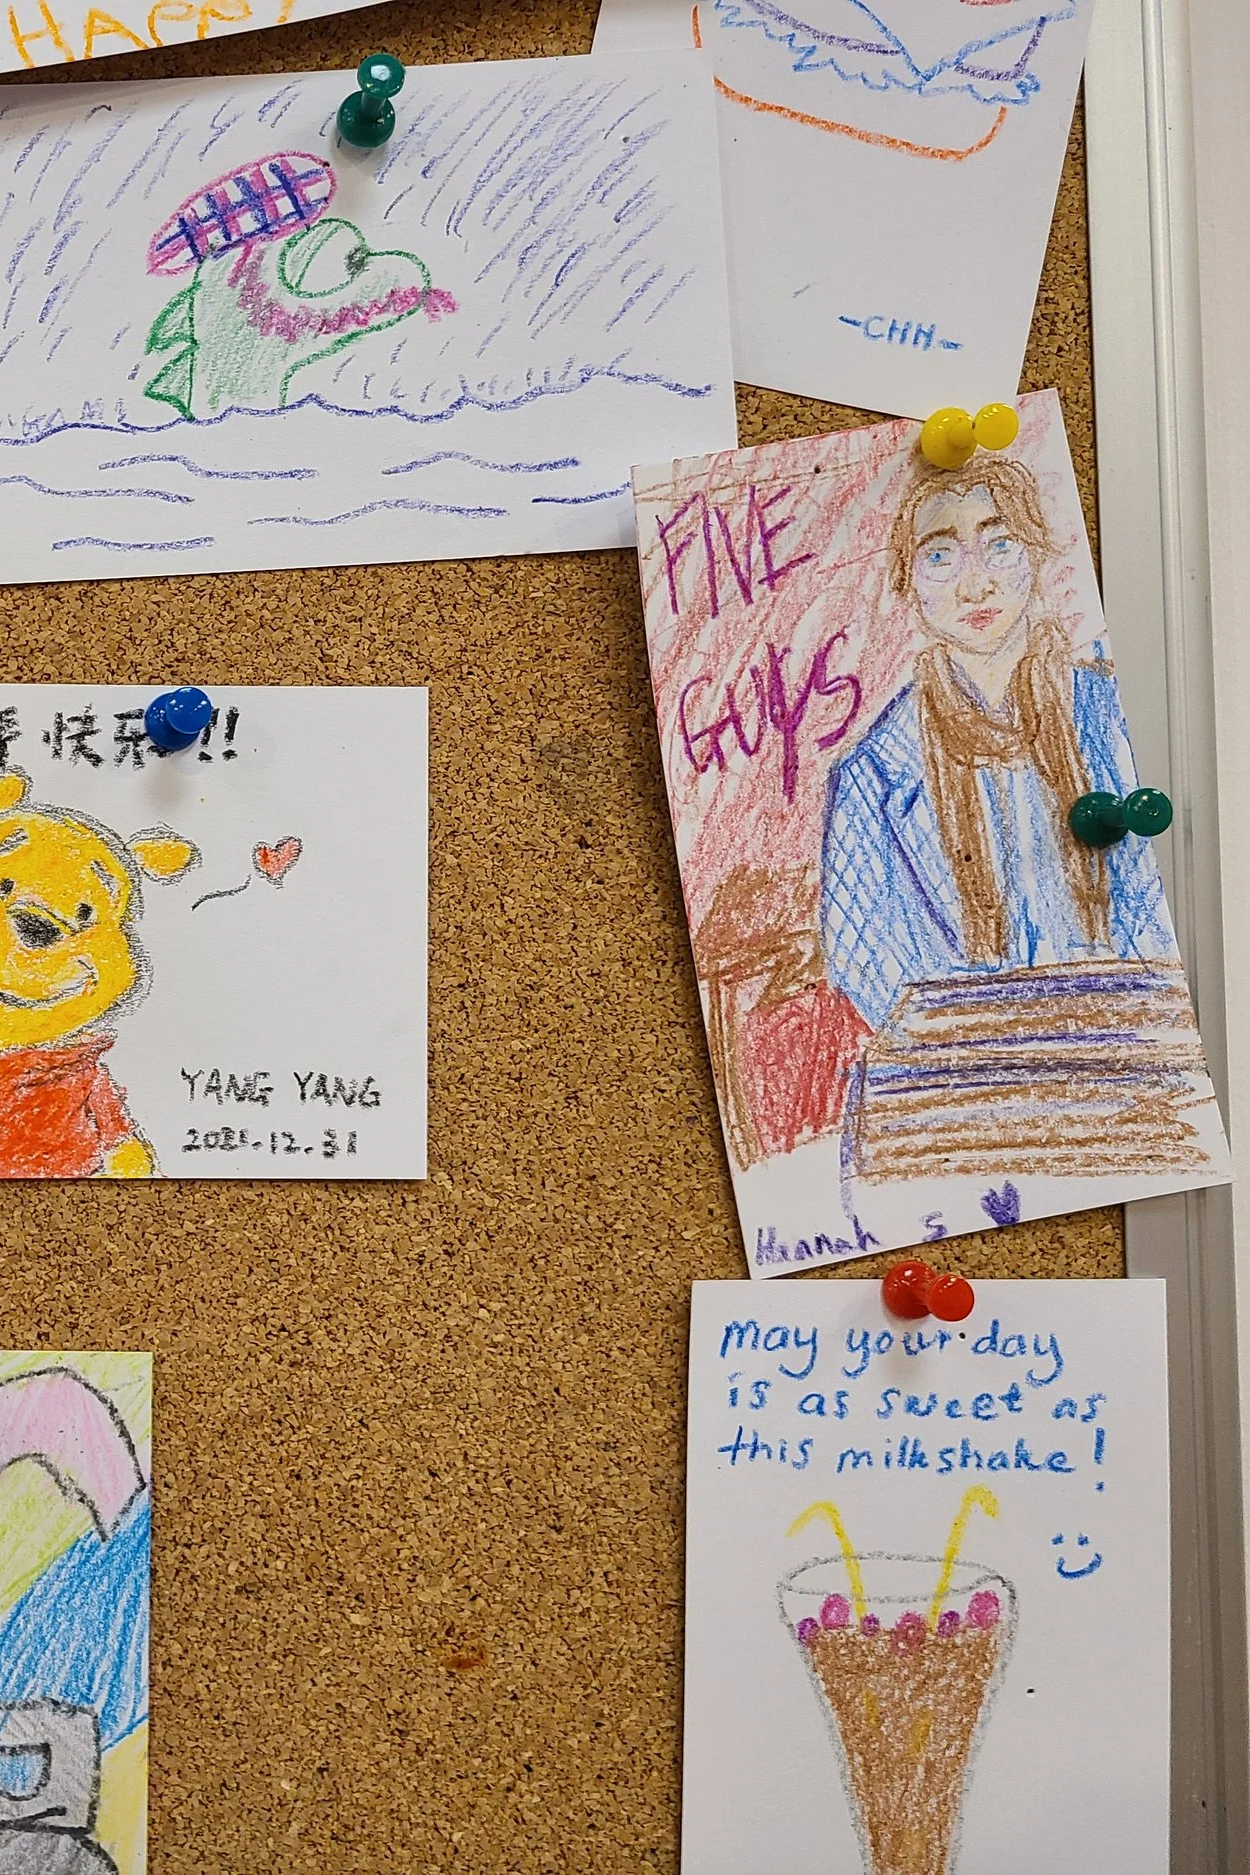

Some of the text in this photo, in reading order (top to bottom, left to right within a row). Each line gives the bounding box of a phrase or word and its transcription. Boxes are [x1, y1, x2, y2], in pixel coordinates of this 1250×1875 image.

[655, 483, 817, 620] FIVE
[679, 629, 864, 804] GUYS
[180, 1067, 382, 1108] YANG YANG
[841, 1326, 953, 1380] your
[970, 1318, 1065, 1388] day
[726, 1370, 1108, 1423] is as sweet as
[716, 1425, 815, 1470] this
